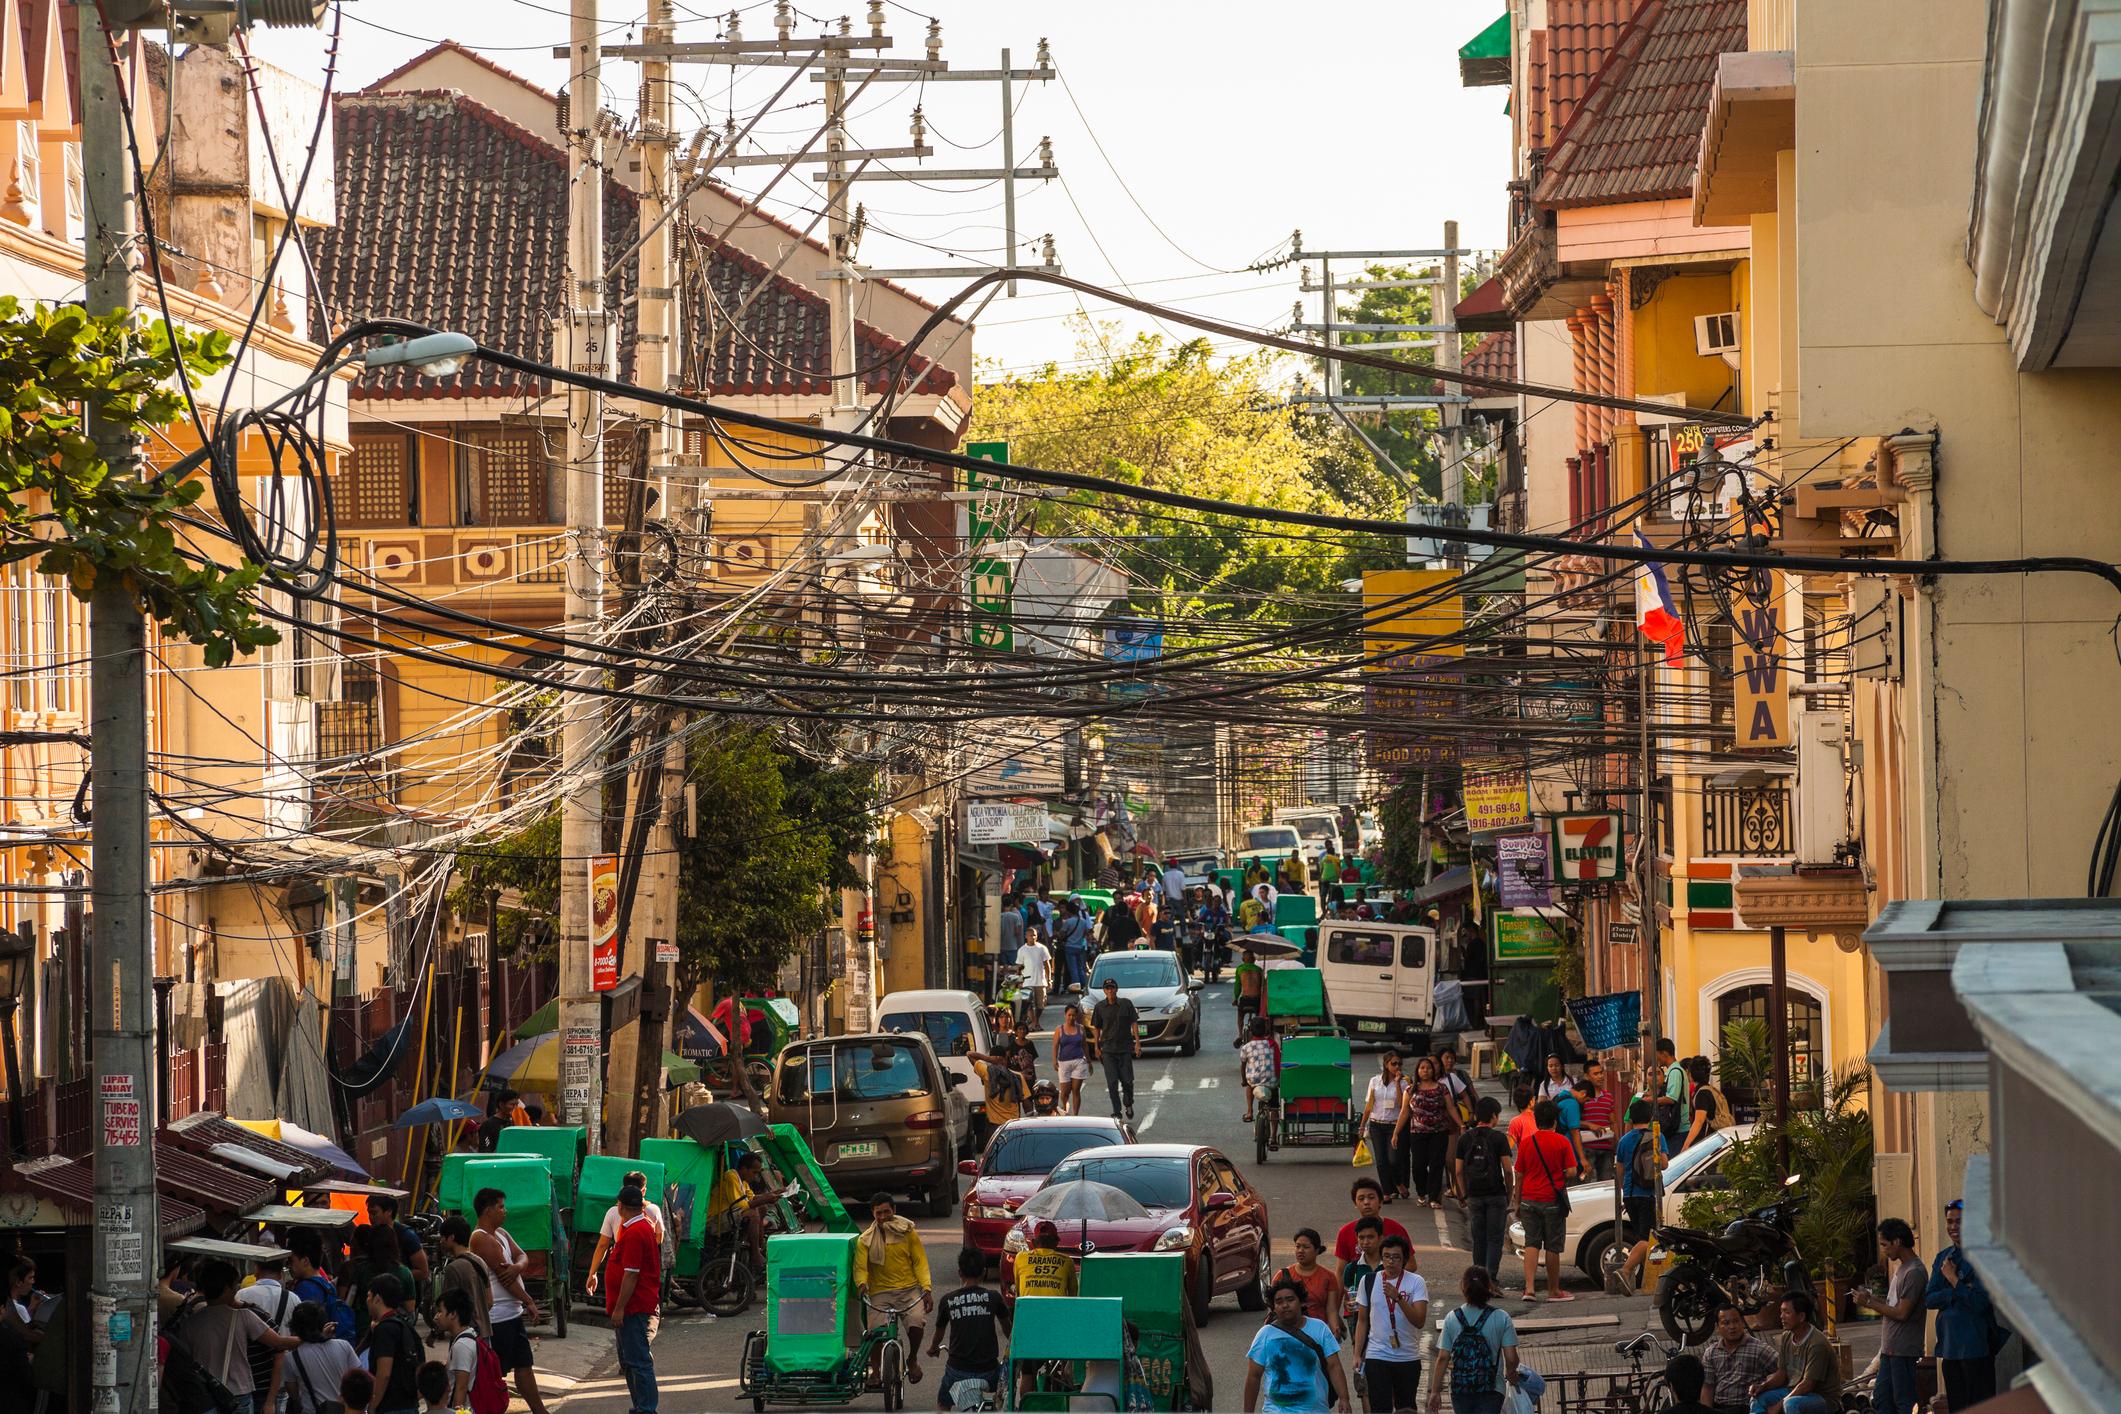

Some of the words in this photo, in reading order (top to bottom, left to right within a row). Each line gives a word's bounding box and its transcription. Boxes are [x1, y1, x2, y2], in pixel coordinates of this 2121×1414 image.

[586, 342, 598, 352] 25
[1683, 426, 1700, 434] OVER
[1702, 426, 1732, 434] COMPUTERS
[984, 806, 1008, 816] VICTORIA
[1478, 802, 1520, 814] 491-69-83
[974, 817, 1004, 828] LAUNDRY
[1014, 816, 1037, 828] REPAIR
[1038, 816, 1043, 827] &
[1010, 828, 1047, 840] ACCESSORIES
[1564, 818, 1610, 880] 7
[566, 1045, 593, 1054] 381-6718
[566, 1089, 581, 1098] HEPA
[584, 1089, 588, 1098] B
[105, 1102, 139, 1115] TUBERO
[105, 1116, 138, 1128] SERVICE
[1028, 1256, 1066, 1268] BARANGAY
[1034, 1266, 1059, 1275] 657
[1026, 1280, 1061, 1290] INTRAMUROS
